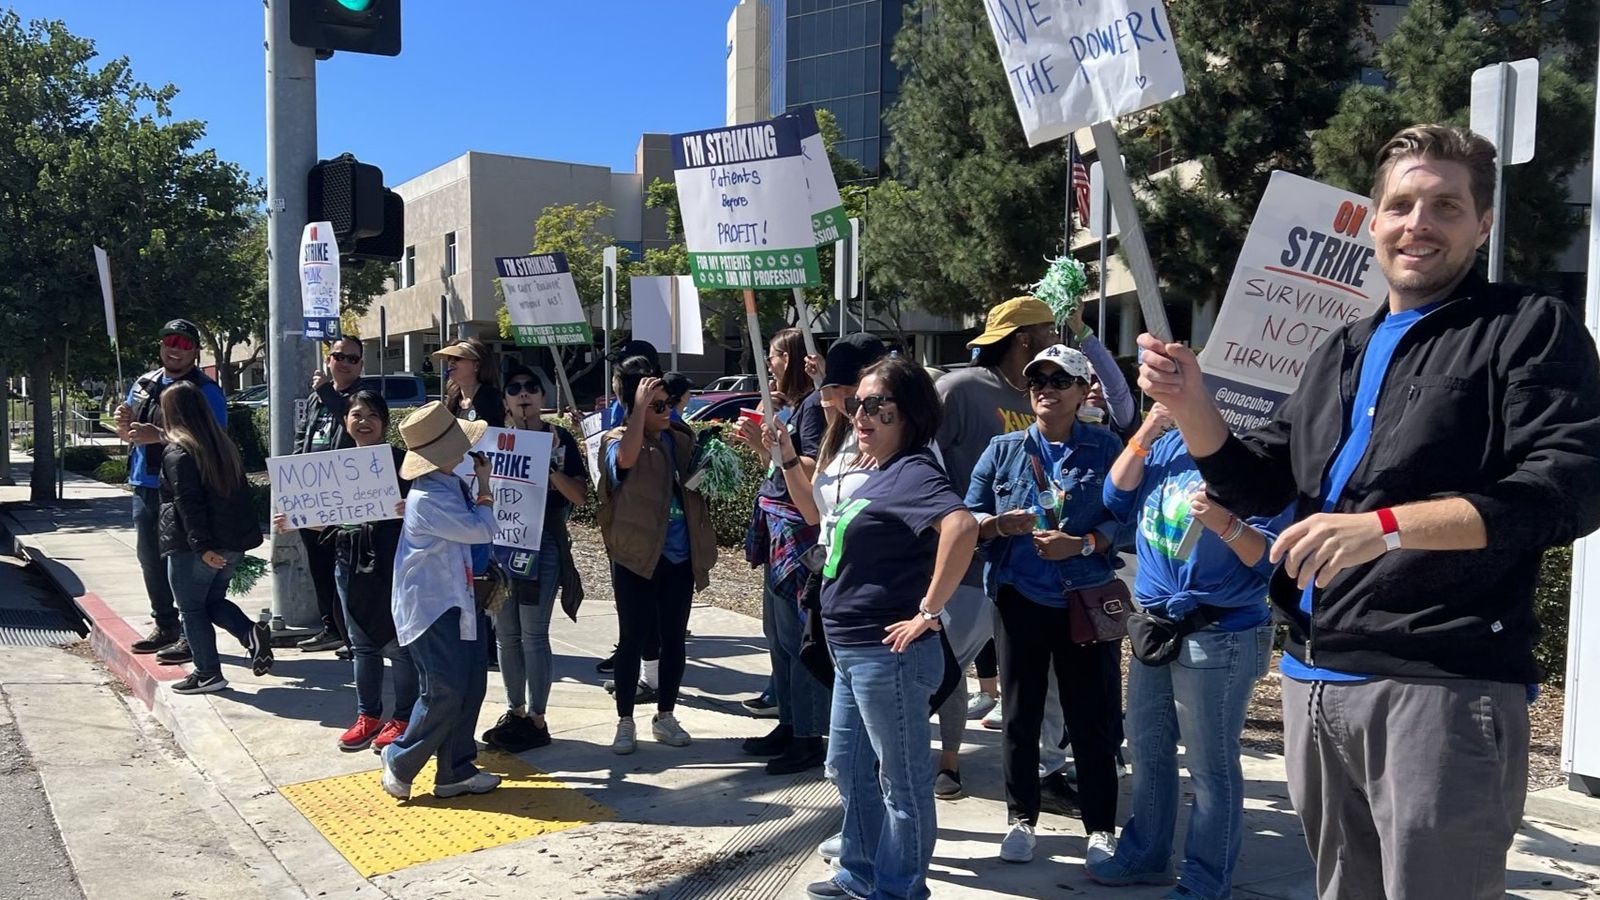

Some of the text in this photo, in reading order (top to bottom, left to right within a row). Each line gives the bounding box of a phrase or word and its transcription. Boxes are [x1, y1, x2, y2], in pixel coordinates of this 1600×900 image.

[1010, 7, 1168, 109] THE POWER!
[683, 124, 778, 167] I'M STRIKING
[710, 167, 761, 189] Patients
[1332, 200, 1368, 238] ON
[814, 226, 840, 246] SSION
[304, 242, 329, 262] STRIKE
[502, 254, 558, 277] I'M STRIKING
[697, 254, 751, 270] FOR MY PATIENTS
[1280, 226, 1376, 287] STRIKE
[725, 268, 807, 287] AND MY PROFESSION
[1245, 278, 1361, 325] SURVIVING
[556, 333, 585, 344] PROFESSION
[1261, 314, 1329, 350] NOT
[1224, 341, 1305, 378] THRIVIN
[1215, 387, 1275, 415] @unacuhcp
[497, 432, 516, 452] ON
[279, 455, 360, 493] MOM'S
[486, 450, 532, 479] TRIKE
[278, 484, 397, 512] BABIES deserve
[493, 486, 523, 505] ITED
[316, 500, 388, 524] BETTER!
